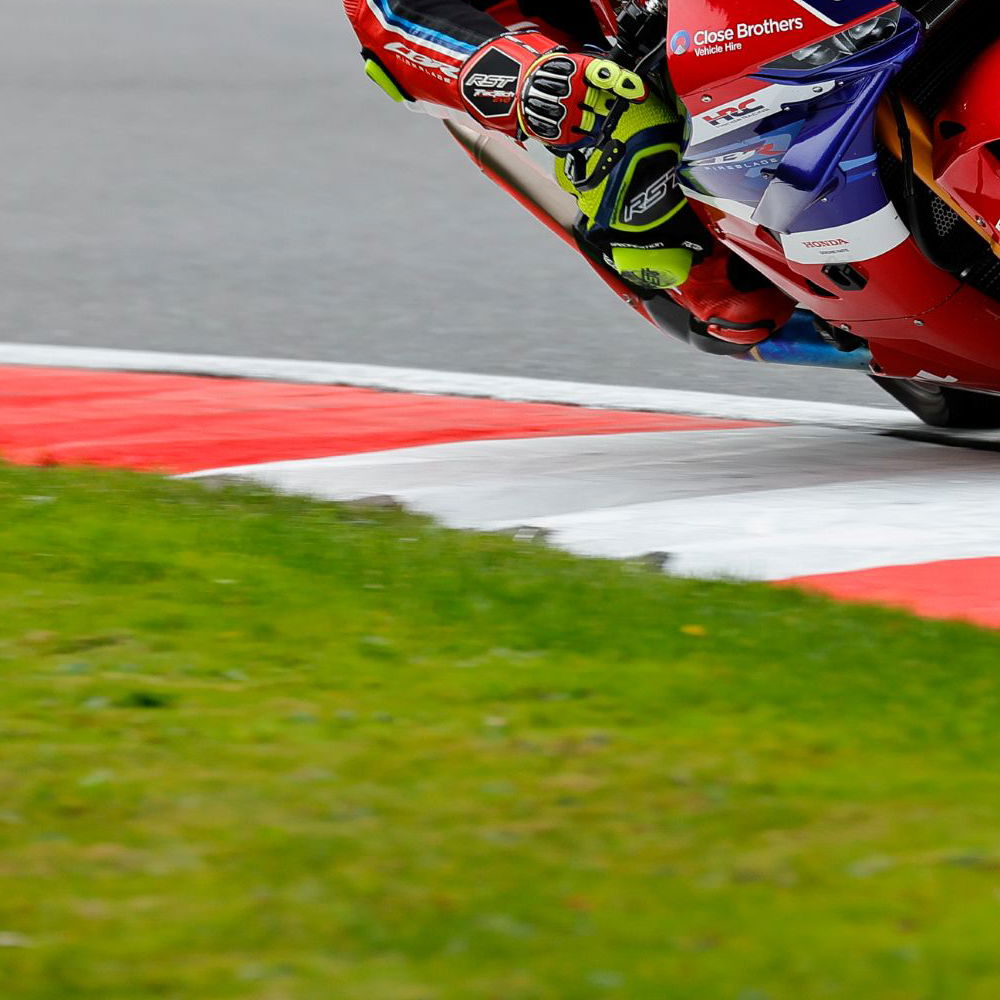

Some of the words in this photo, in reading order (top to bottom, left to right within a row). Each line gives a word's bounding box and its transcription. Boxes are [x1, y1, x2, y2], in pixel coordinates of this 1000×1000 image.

[693, 31, 734, 46] Close
[736, 17, 803, 39] Brothers
[694, 45, 723, 57] Vehicle
[725, 41, 742, 53] Hire
[465, 73, 518, 88] RST
[802, 239, 849, 249] HONDA
